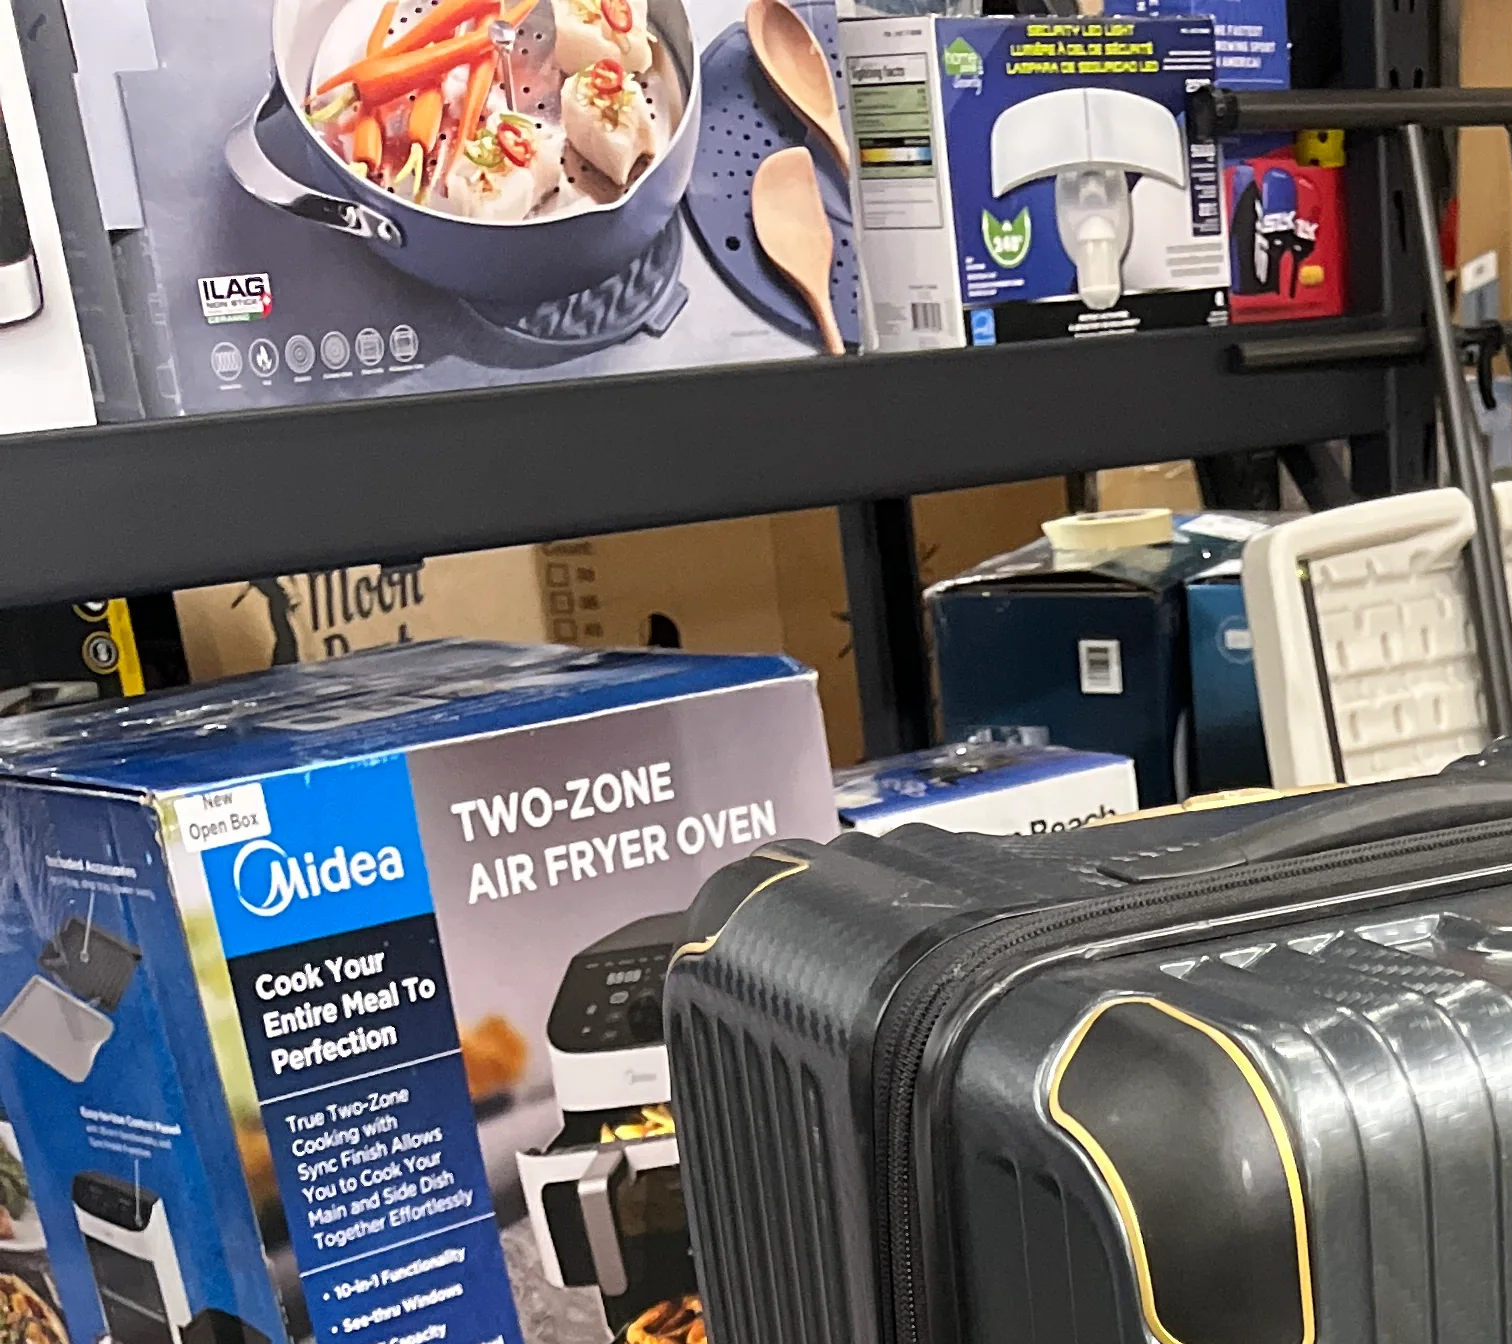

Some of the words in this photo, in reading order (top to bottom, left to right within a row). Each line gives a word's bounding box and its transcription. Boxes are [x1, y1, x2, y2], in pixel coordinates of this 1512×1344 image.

[202, 276, 265, 301] ILAG
[189, 820, 228, 842] Open
[230, 812, 260, 831] Box
[202, 792, 233, 810] New
[451, 762, 675, 842] TWO-ZONE
[233, 839, 405, 917] Midea
[469, 853, 537, 905] AIR
[545, 825, 669, 887] FRYER
[677, 800, 777, 855] OVEN
[255, 963, 324, 1001] Cook
[325, 952, 385, 984] Your
[263, 1003, 338, 1039] Entire
[342, 982, 400, 1018] Meal
[402, 976, 436, 1003] To
[271, 1024, 398, 1075] Perfection
[286, 1112, 325, 1134] True
[326, 1088, 410, 1123] Two-Zone
[292, 1126, 360, 1158] Cooking
[361, 1114, 399, 1139] with
[298, 1157, 338, 1182] Sync
[341, 1142, 389, 1168] Finish
[391, 1127, 443, 1153] Allows
[302, 1183, 337, 1205] You
[338, 1175, 358, 1193] to
[360, 1162, 403, 1188] Cook
[404, 1151, 442, 1175] Your
[308, 1205, 348, 1228] Main
[350, 1192, 381, 1217] and
[382, 1178, 418, 1206] Side
[420, 1169, 455, 1194] Dish
[313, 1215, 387, 1250] Together
[388, 1188, 474, 1228] Effortlessly
[333, 1273, 380, 1301] 10-in-1
[380, 1247, 466, 1286] Functionality
[401, 1282, 465, 1313] Windows
